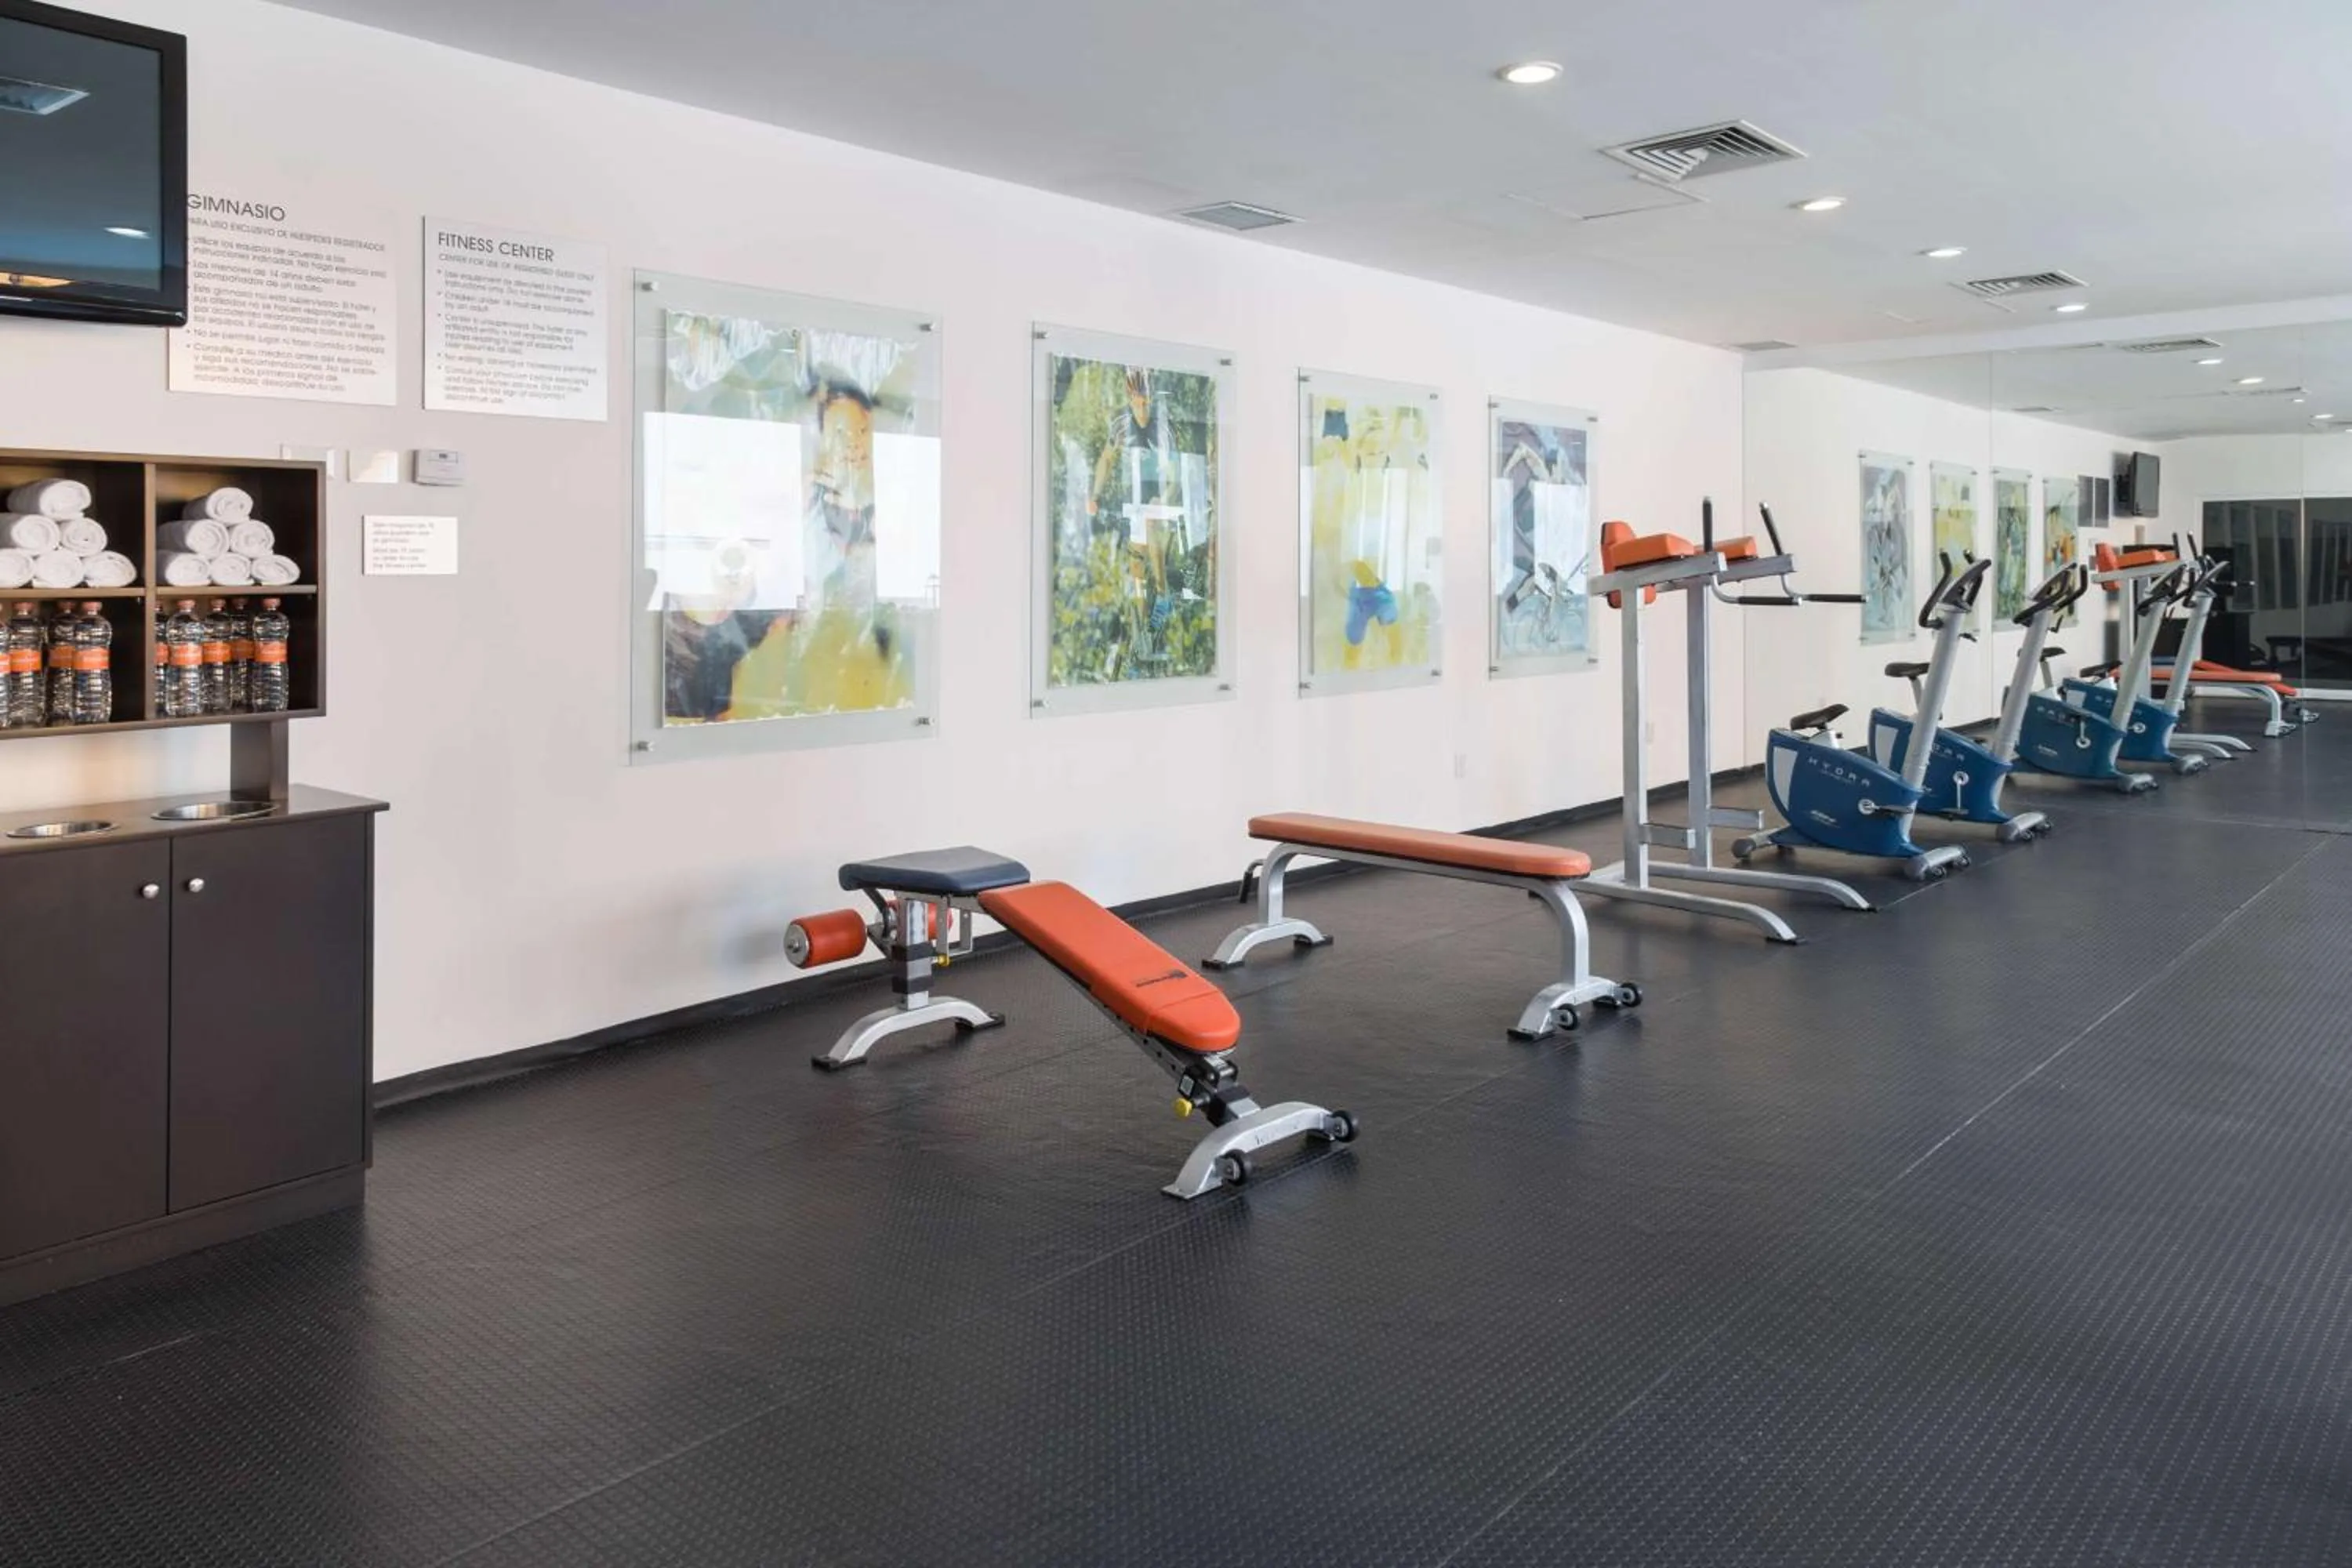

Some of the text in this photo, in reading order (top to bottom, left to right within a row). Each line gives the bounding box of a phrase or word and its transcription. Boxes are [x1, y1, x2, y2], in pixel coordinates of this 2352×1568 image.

[188, 194, 285, 221] GIMNASIO
[189, 216, 209, 227] ARA
[438, 232, 554, 262] FITNESS CENTER
